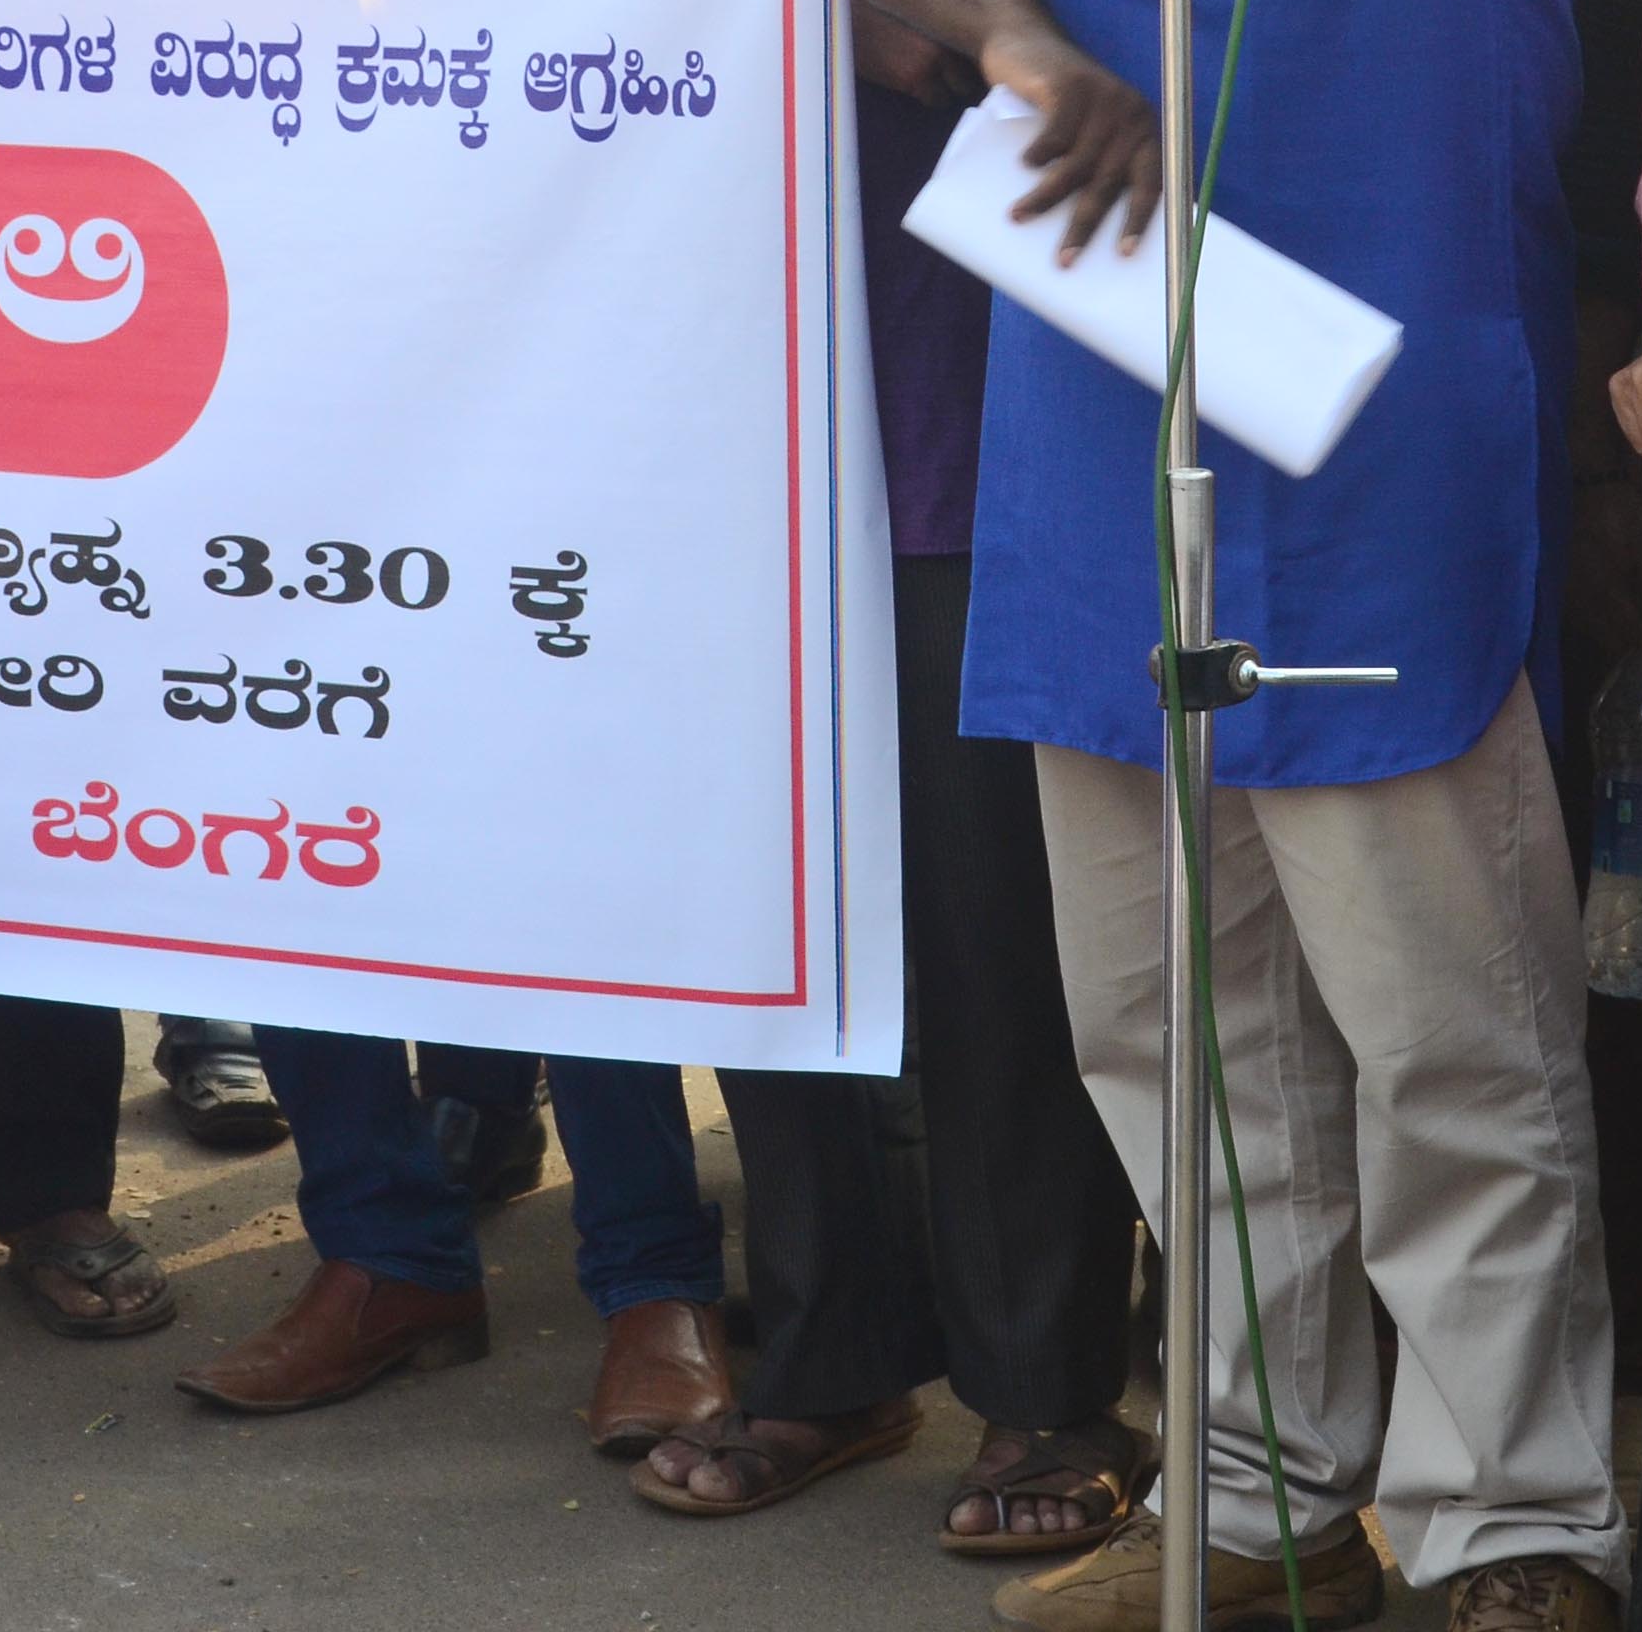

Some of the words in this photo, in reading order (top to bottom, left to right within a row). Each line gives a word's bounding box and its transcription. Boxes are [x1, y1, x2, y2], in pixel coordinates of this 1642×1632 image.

[150, 20, 304, 148] ವಿರುದ್ಧ
[336, 24, 493, 151] ಕ್ರಮಕ್ಕೆ
[523, 33, 718, 144] ಆಗ್ರಹಿಸಿ
[202, 534, 451, 611] 3.30
[509, 549, 591, 659] ಕ್ಕೆ
[162, 651, 392, 741] ವರೆಗೆ
[32, 779, 382, 889] ಬೆಂಗರೆ
